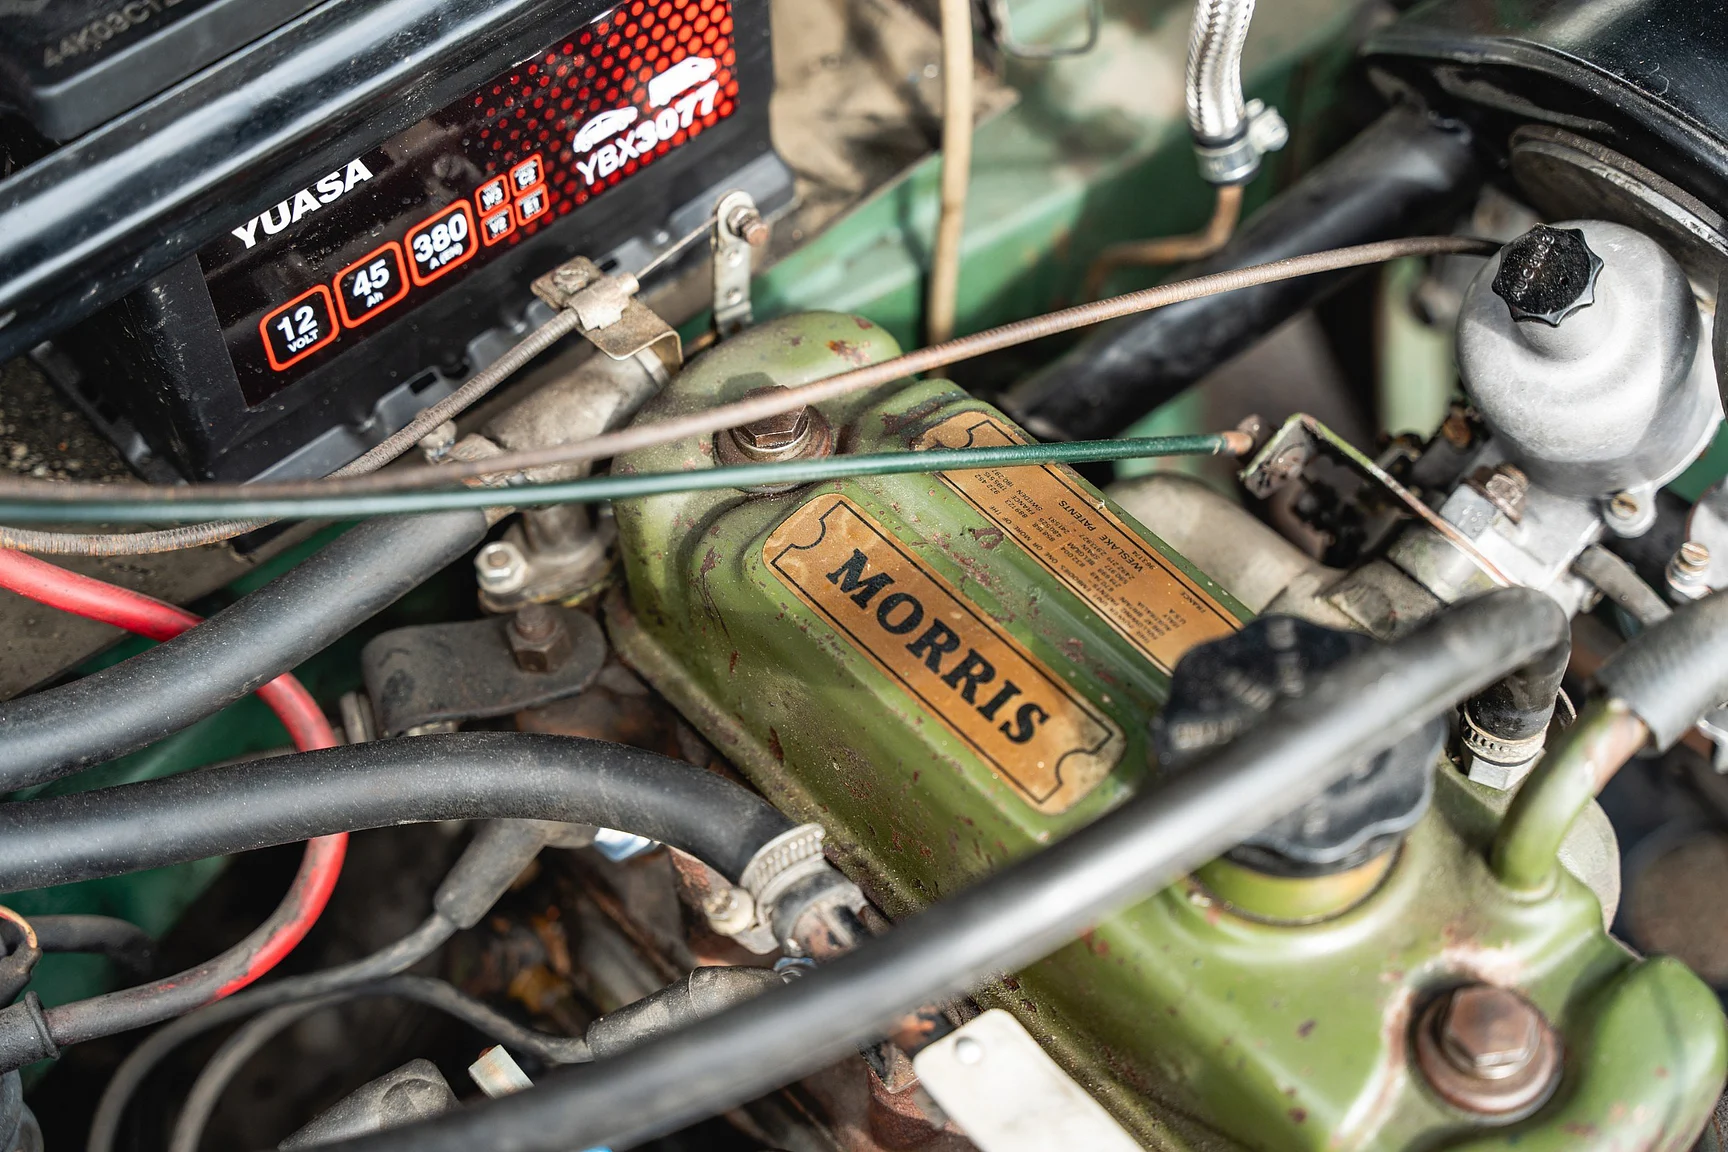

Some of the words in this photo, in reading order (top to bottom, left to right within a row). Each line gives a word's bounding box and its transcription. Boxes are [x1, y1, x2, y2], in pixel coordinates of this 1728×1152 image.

[576, 79, 720, 186] YBX3077
[231, 158, 374, 249] YUASA
[412, 213, 468, 263] 380
[352, 258, 391, 298] 45
[365, 291, 384, 308] Ah
[277, 305, 318, 342] 12
[287, 328, 319, 353] VOLT
[988, 505, 1002, 516] THE
[1010, 494, 1036, 515] FRANCE
[1015, 489, 1043, 511] SWEDEN
[1001, 516, 1012, 525] OF
[1058, 500, 1096, 531] PATENTS
[1013, 524, 1032, 541] MORE
[1031, 541, 1043, 551] OR
[1043, 551, 1059, 564] ONE
[1066, 541, 1095, 566] BELGIUM
[1080, 543, 1101, 560] SPAIN
[1098, 534, 1143, 572] WESLAKE
[1060, 564, 1091, 592] EMBODIES
[1093, 594, 1108, 606] UNIT
[1179, 591, 1206, 614] FRANCE
[825, 548, 1050, 745] MORRIS
